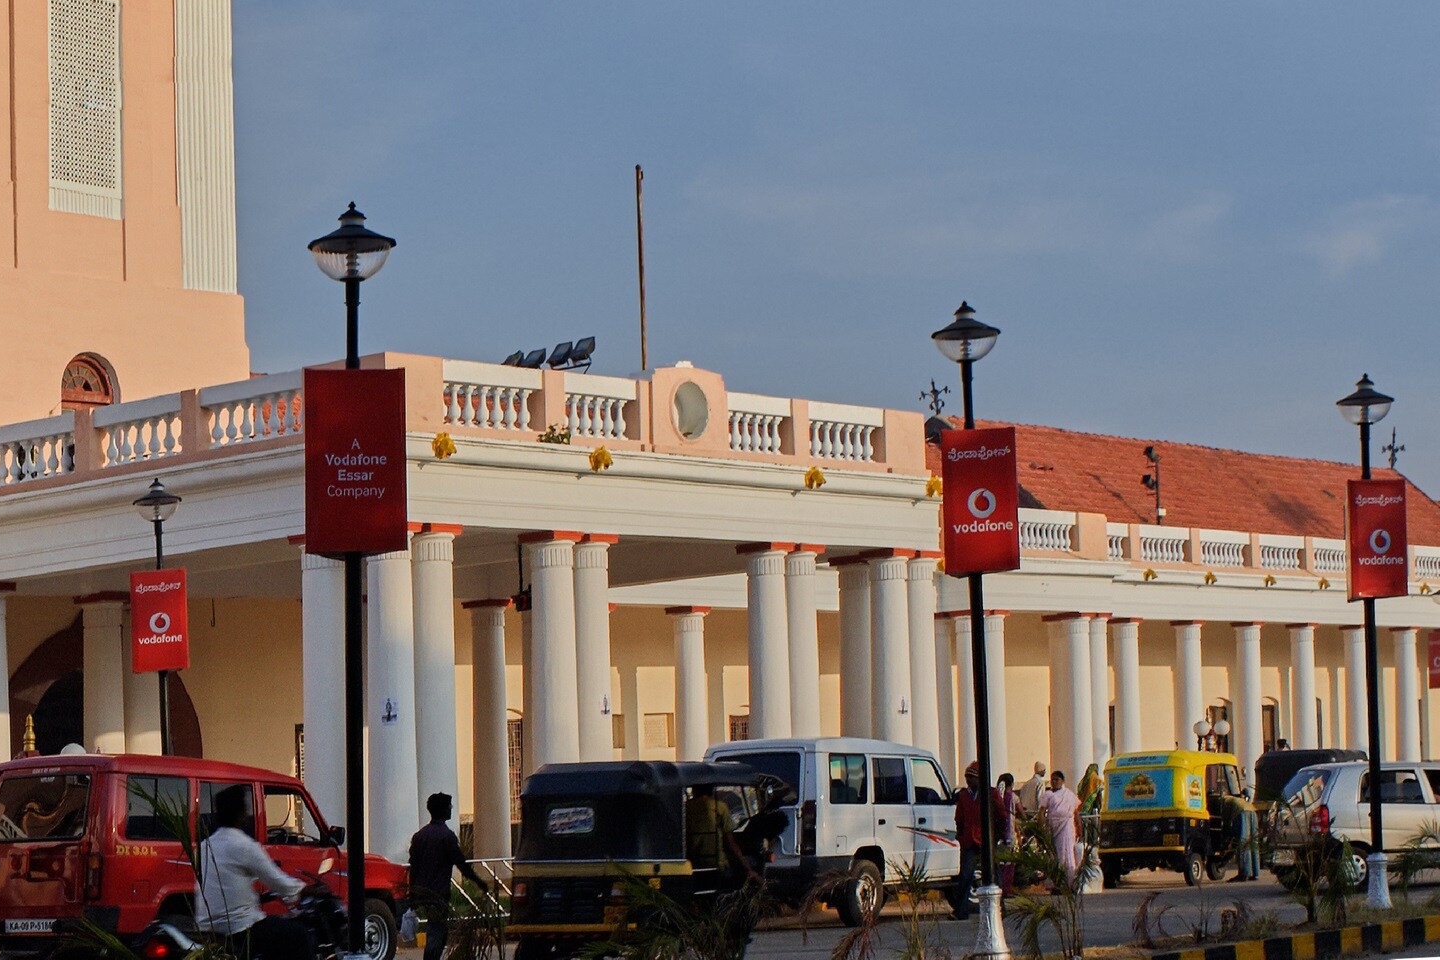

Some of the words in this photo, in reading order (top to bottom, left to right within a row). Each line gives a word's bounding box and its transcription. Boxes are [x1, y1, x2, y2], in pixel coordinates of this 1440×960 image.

[351, 437, 360, 450] A
[324, 453, 387, 466] Vodafone
[337, 469, 374, 481] Essar
[327, 485, 386, 499] Company
[953, 519, 1014, 534] vodafone
[1358, 555, 1404, 566] vodafone
[138, 633, 183, 645] vodafone
